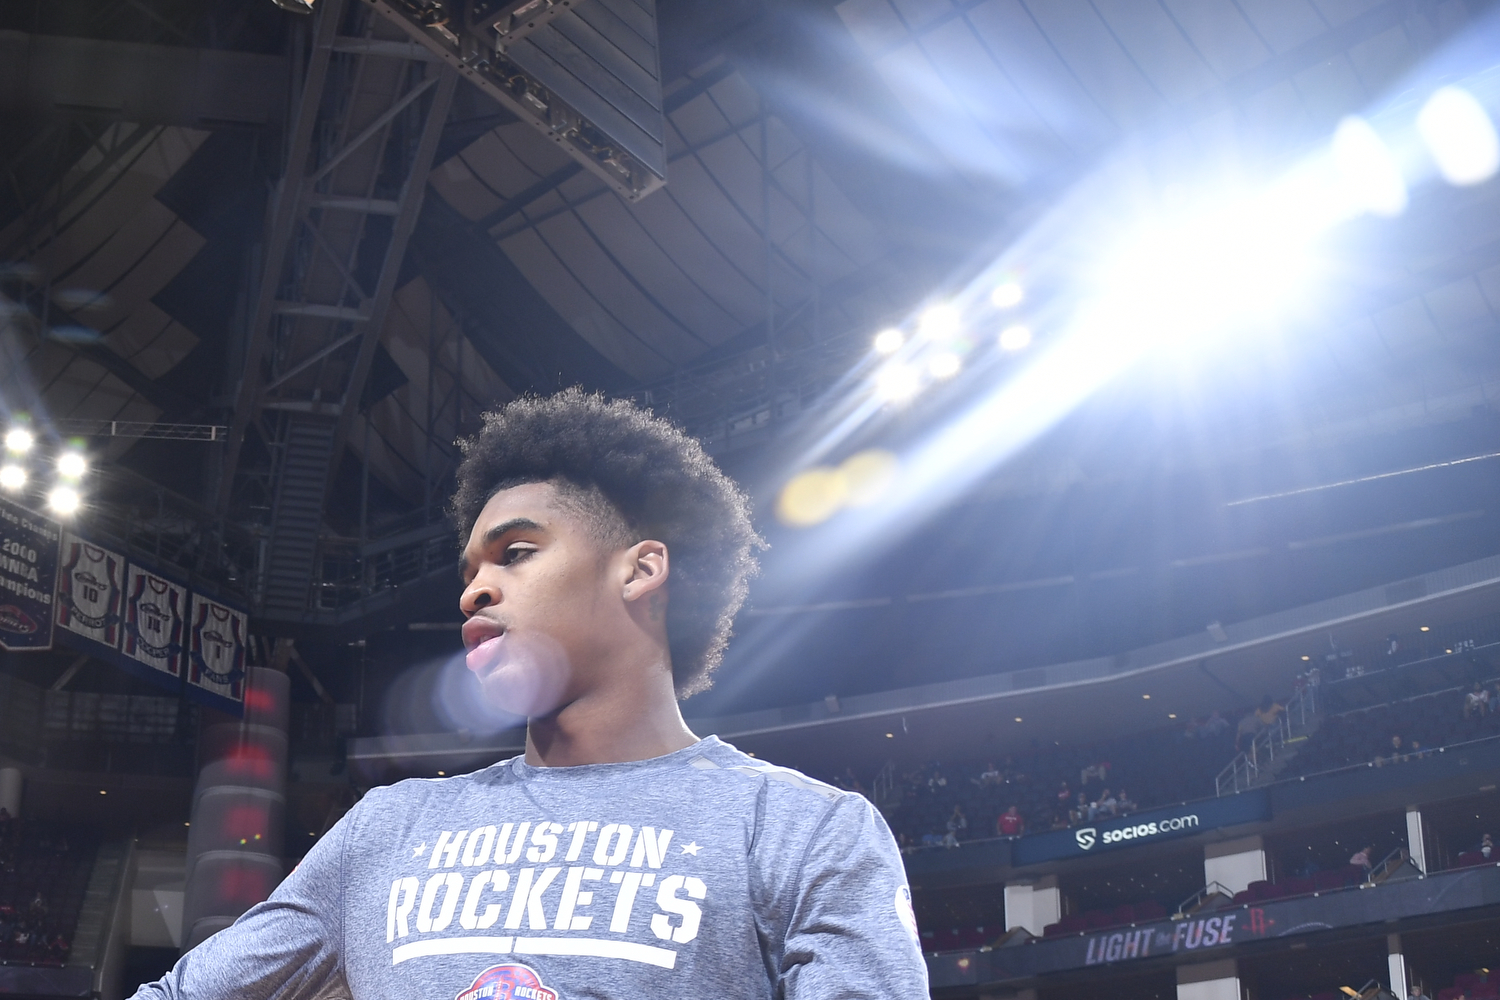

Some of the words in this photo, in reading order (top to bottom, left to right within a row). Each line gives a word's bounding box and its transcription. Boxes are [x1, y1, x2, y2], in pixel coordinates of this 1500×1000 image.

[2, 538, 37, 563] 2000
[82, 585, 98, 603] 10
[428, 821, 674, 869] HOUSTON
[386, 866, 708, 944] ROCKETS
[1085, 928, 1155, 965] LIGHT
[1172, 915, 1236, 952] FUSE
